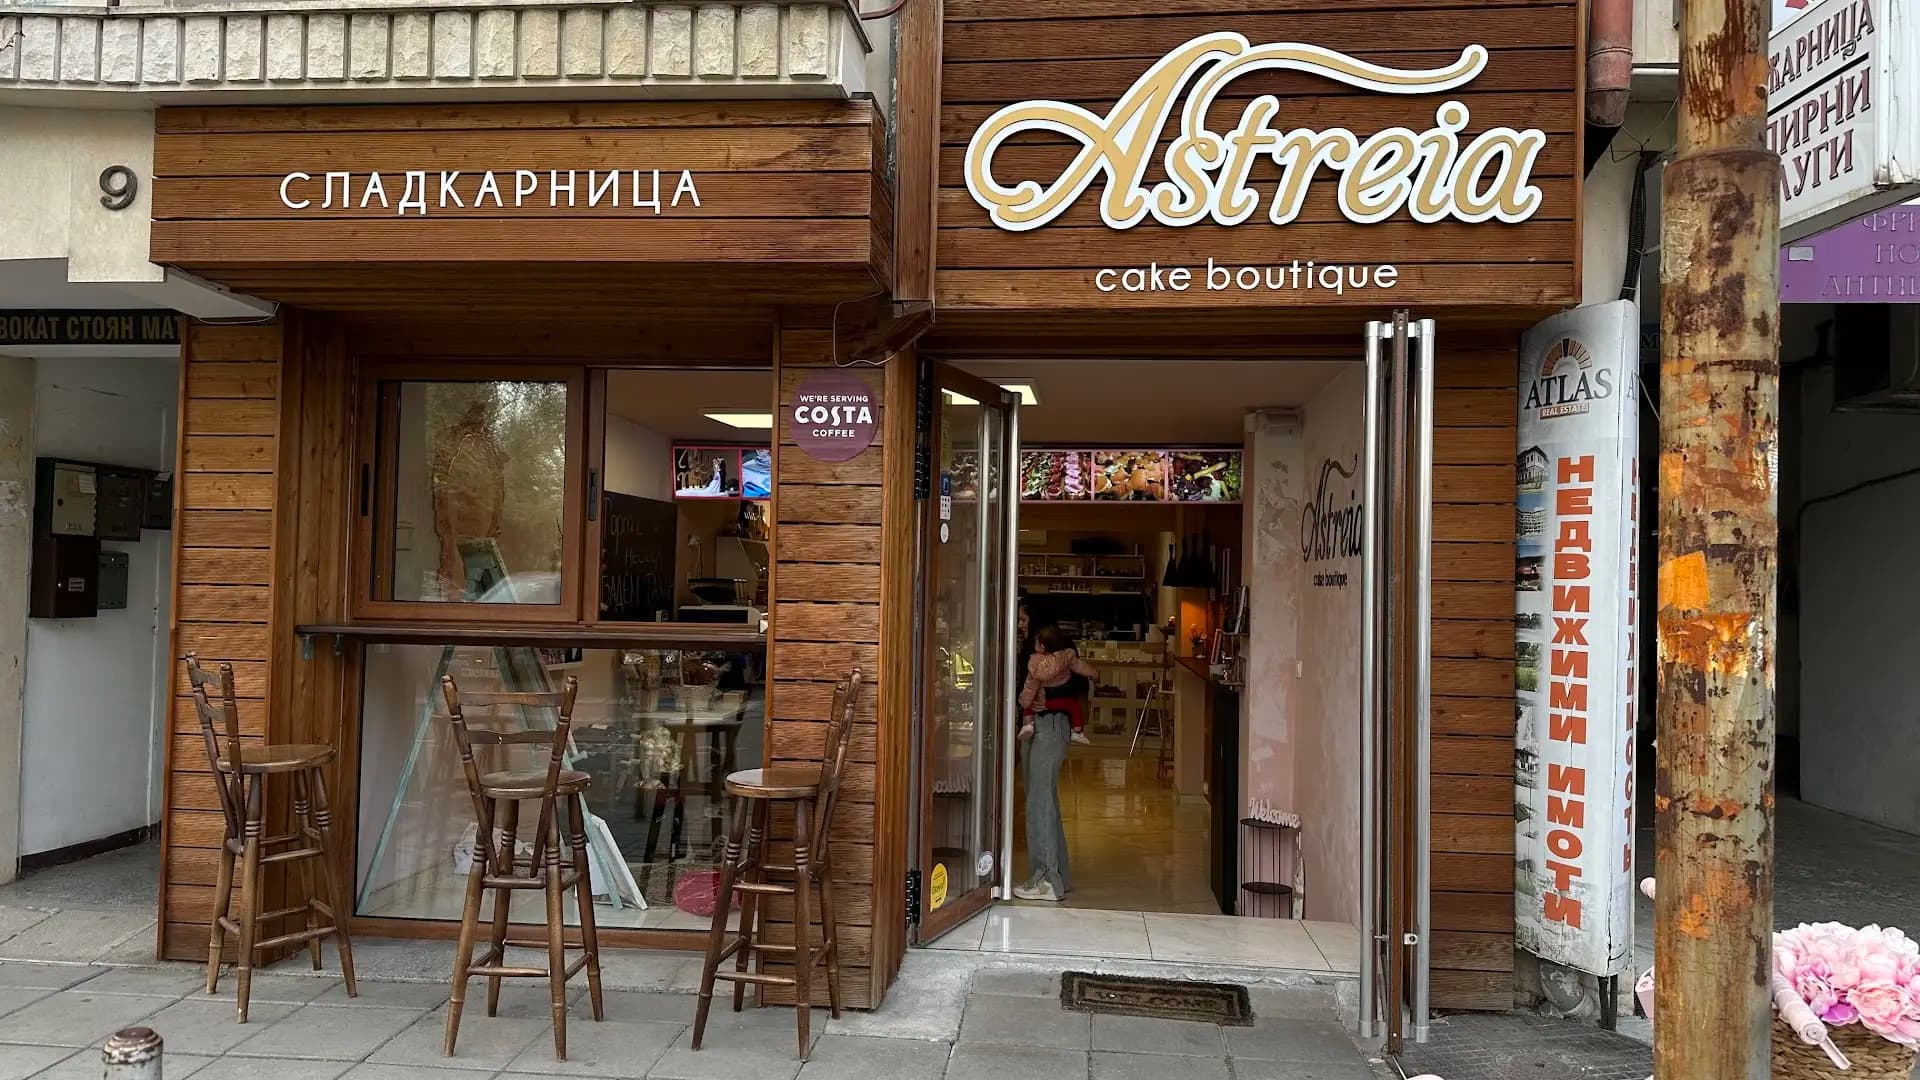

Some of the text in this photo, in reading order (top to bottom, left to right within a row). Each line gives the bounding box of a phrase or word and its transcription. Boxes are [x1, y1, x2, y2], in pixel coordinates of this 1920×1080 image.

[965, 32, 1546, 231] Astreia
[99, 165, 138, 211] 9
[280, 169, 701, 215] СЛАДКАРНИЦА
[1095, 258, 1398, 295] cake boutique
[66, 315, 134, 340] СТОЯН
[799, 395, 869, 403] WE'RE SERVING
[1524, 368, 1613, 409] ATLAS
[794, 405, 873, 427] COSTA
[812, 429, 856, 438] COFFEE
[1544, 455, 1594, 929] НЕДВИЖИМИ ИМОТИ
[1248, 797, 1302, 829] Welcome
